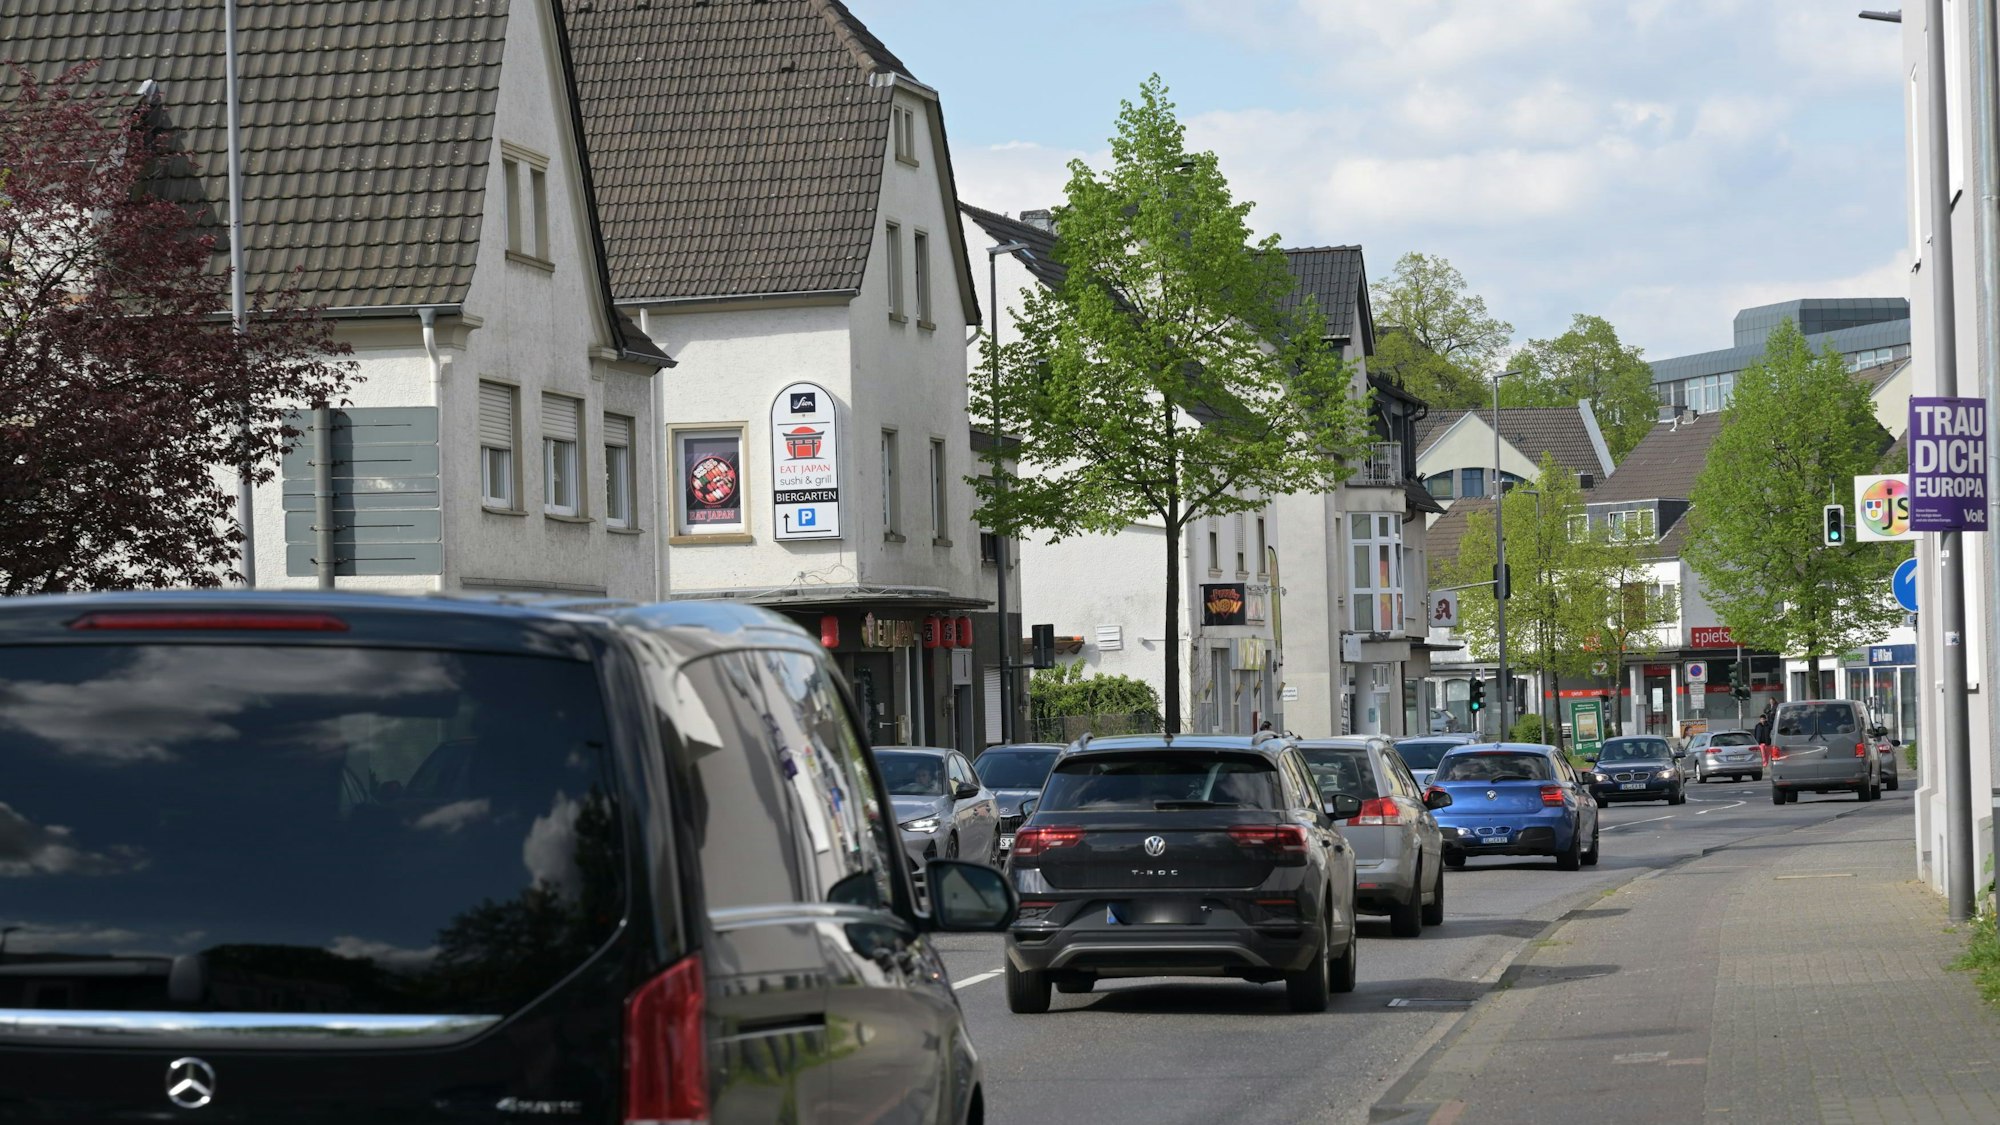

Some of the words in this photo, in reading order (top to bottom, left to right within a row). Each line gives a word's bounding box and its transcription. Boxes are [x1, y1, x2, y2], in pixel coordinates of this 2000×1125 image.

[1915, 406, 1983, 436] TRAU
[1915, 439, 1984, 474] DICH
[780, 465, 797, 474] EAT
[801, 464, 831, 475] JAPAN
[780, 476, 803, 486] sushi
[805, 475, 812, 485] &
[815, 475, 832, 487] grill
[1915, 477, 1985, 498] EUROPA
[776, 491, 837, 502] BIERGARTEN
[689, 511, 706, 521] EAT
[707, 510, 735, 522] JAPAN
[1964, 508, 1984, 523] Volt
